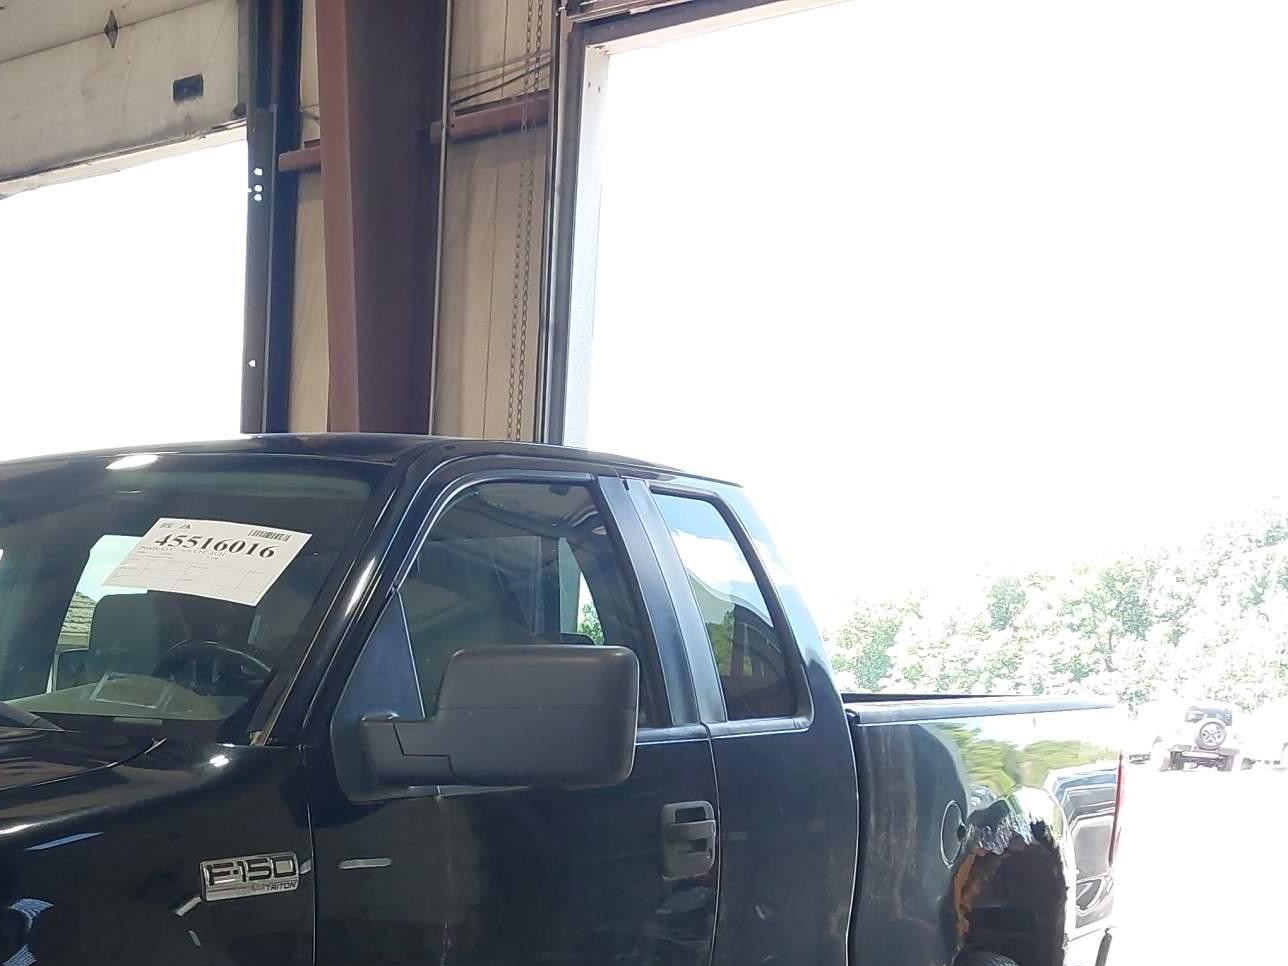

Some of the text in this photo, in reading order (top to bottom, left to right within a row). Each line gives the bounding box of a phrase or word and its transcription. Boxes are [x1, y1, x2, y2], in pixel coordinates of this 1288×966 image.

[155, 534, 280, 559] 45516016
[204, 855, 297, 887] F-150
[265, 881, 297, 891] TRITON
